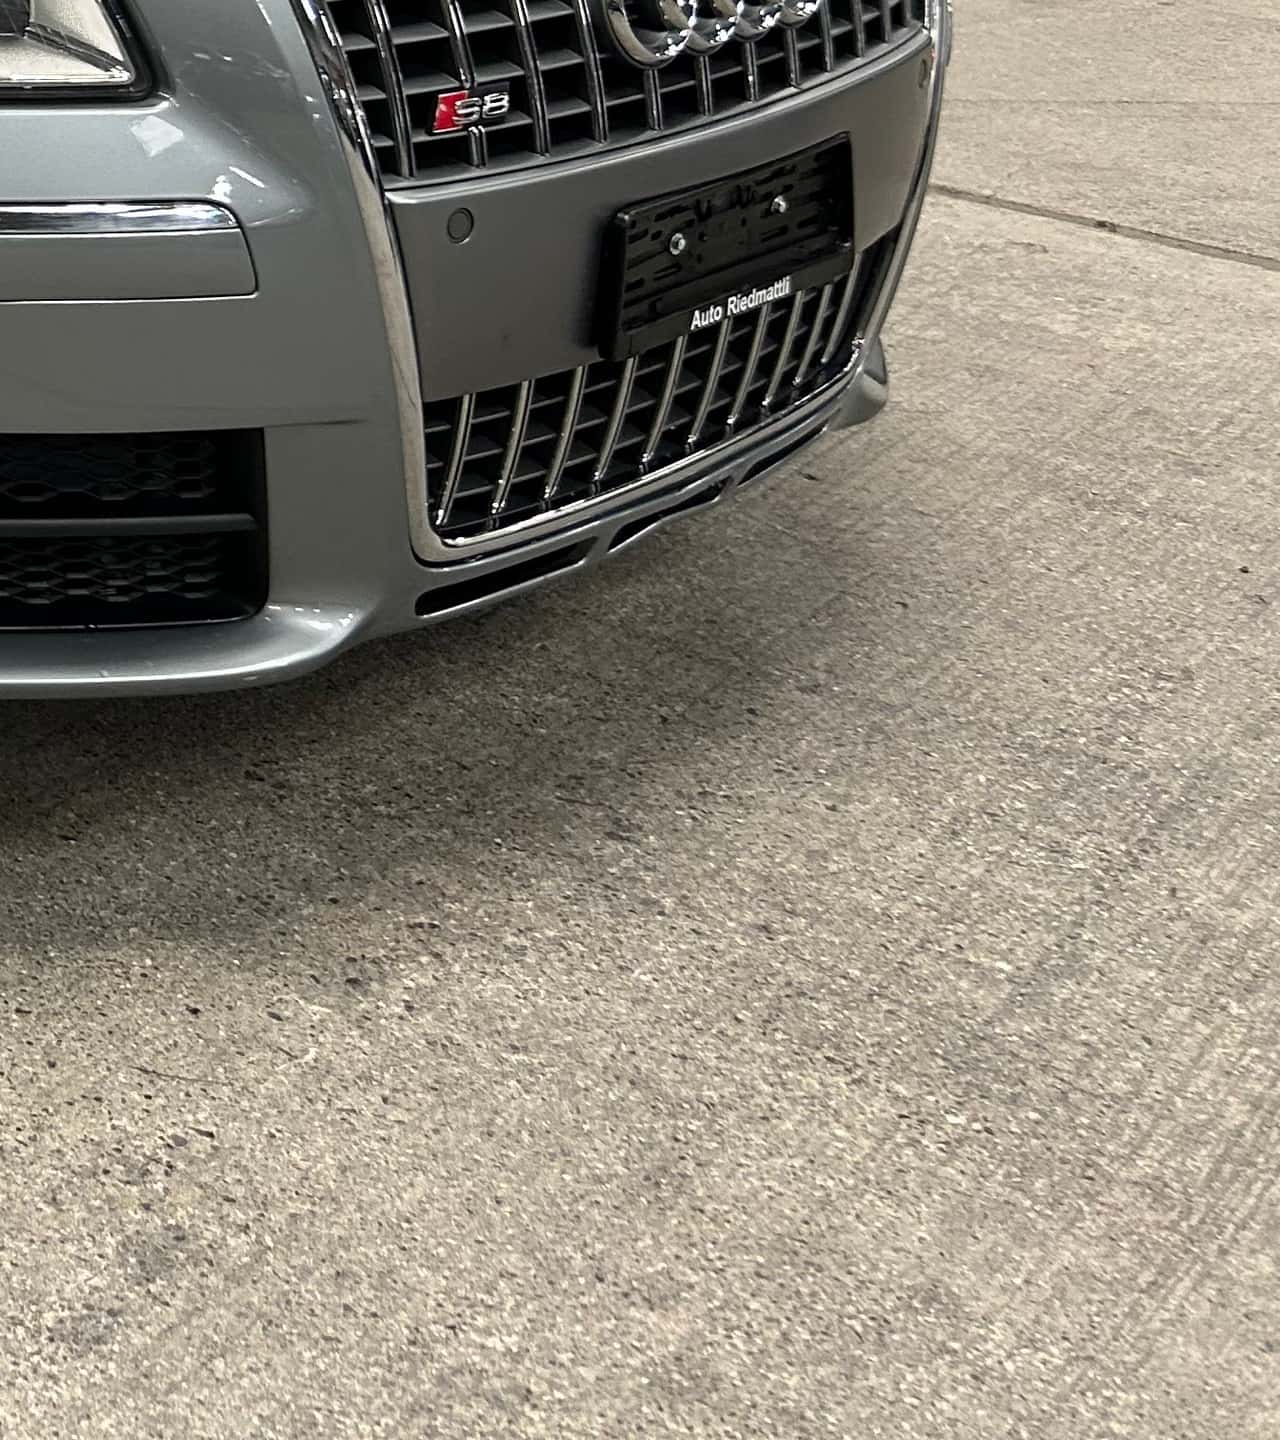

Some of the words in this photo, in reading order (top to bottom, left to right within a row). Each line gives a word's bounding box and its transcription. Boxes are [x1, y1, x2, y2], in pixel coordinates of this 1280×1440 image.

[451, 92, 509, 124] S8
[690, 305, 722, 330] Auto
[727, 275, 790, 316] Riedmattli
